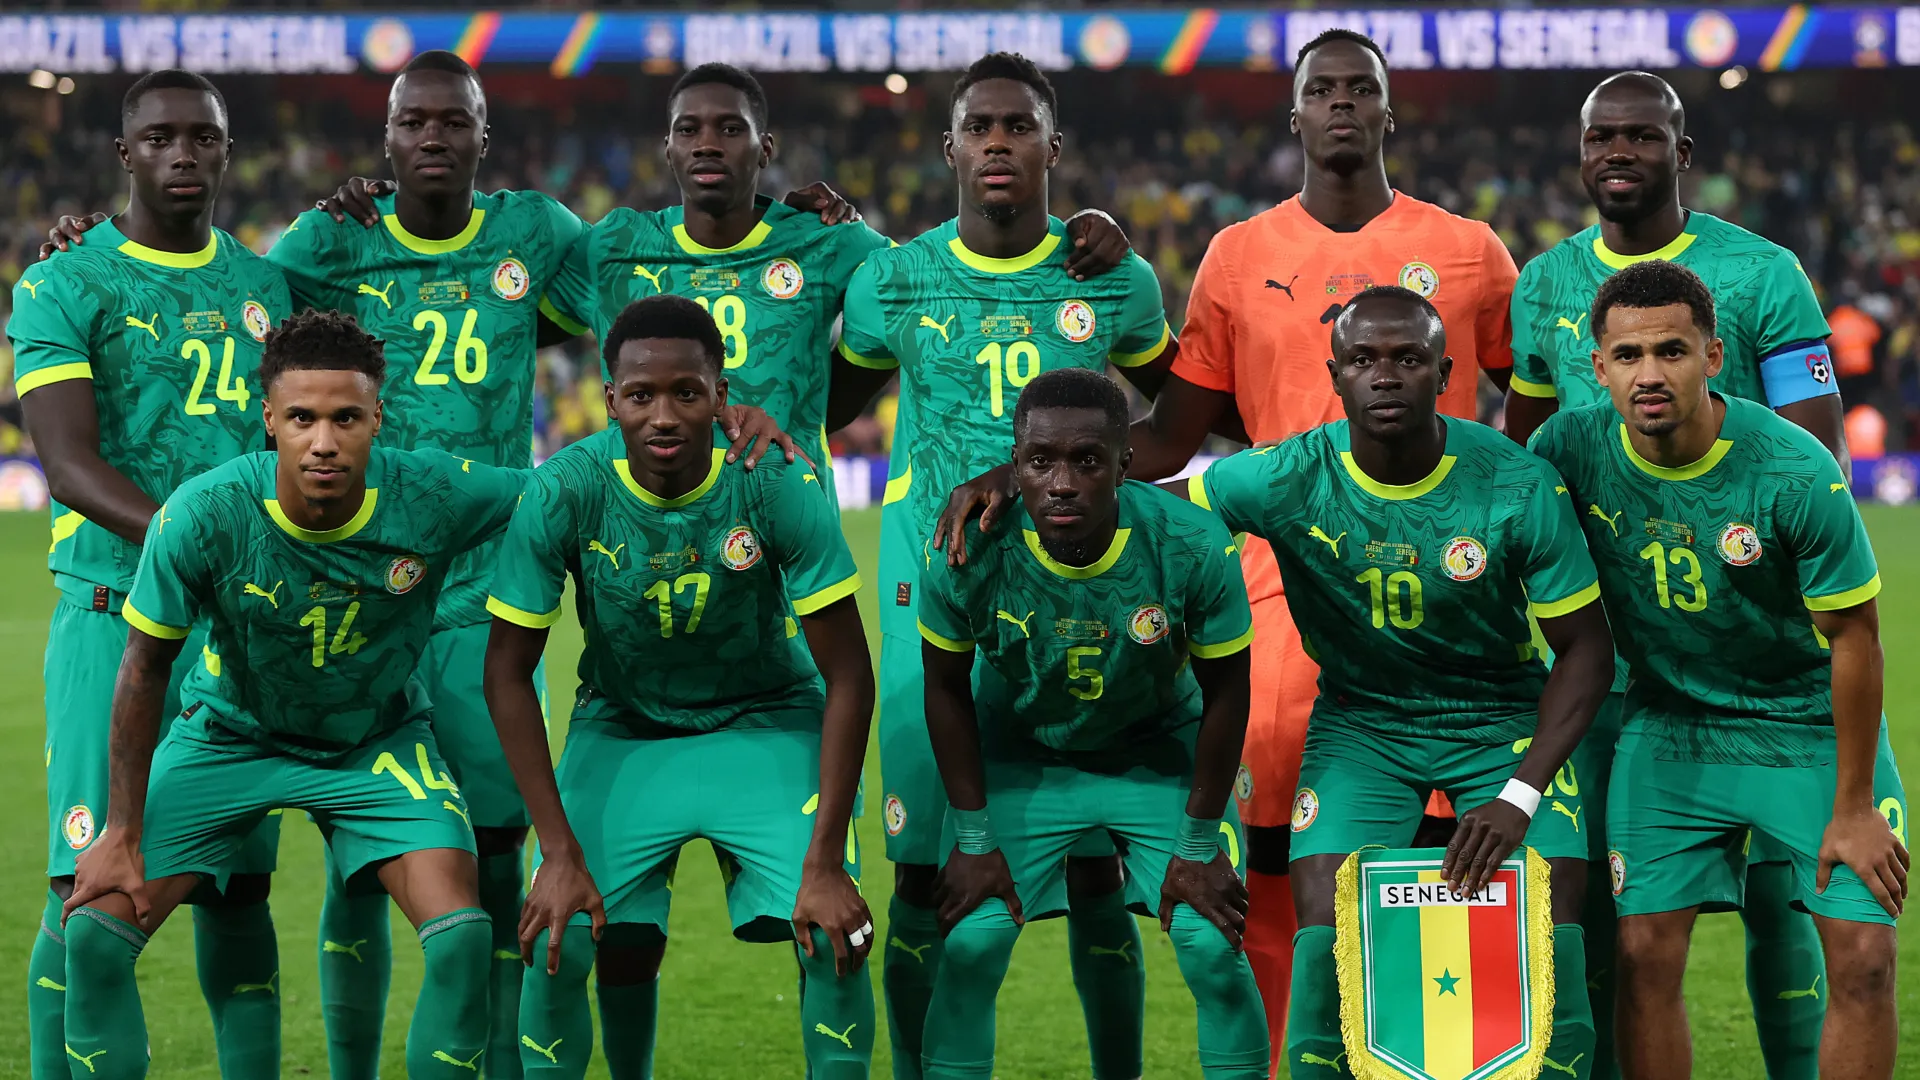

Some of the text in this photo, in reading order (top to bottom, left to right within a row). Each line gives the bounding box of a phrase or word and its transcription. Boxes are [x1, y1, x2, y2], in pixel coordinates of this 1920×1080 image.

[119, 16, 178, 73] VS
[181, 15, 356, 74] SENEGAL
[833, 14, 892, 72] VS
[1435, 10, 1496, 69] VS
[1501, 10, 1680, 69] SENEGAL
[180, 336, 250, 416] 24
[413, 308, 488, 385] 26
[643, 572, 711, 639] 17
[1355, 567, 1424, 630] 10
[1639, 541, 1708, 612] 13
[299, 601, 368, 668] 14
[1067, 646, 1104, 701] 5
[371, 743, 460, 800] 14
[1387, 885, 1497, 904] SENEGAL
